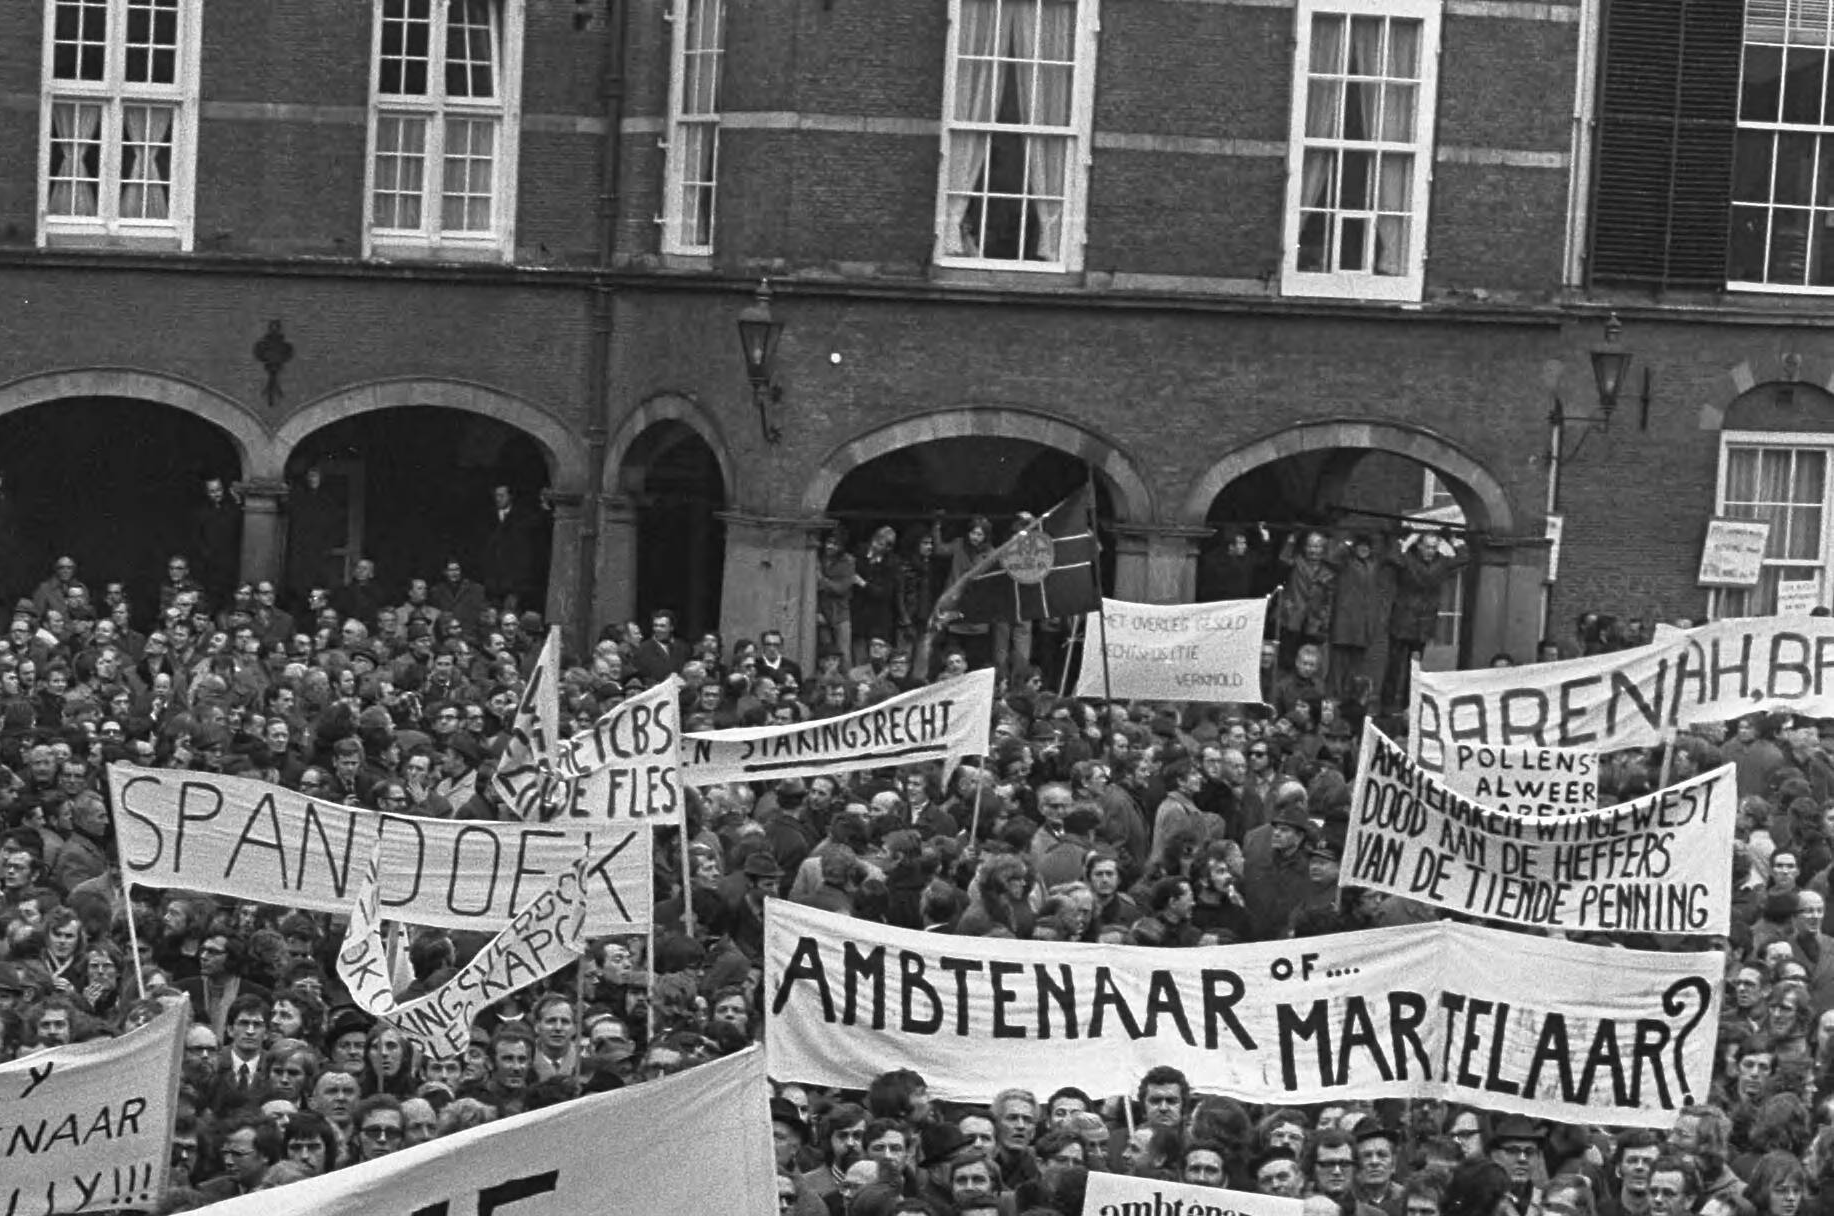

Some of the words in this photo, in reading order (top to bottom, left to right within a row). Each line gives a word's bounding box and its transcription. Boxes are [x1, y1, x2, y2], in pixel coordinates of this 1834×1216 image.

[741, 700, 954, 761] STAKINGSRECHT
[606, 765, 677, 818] FLES
[1360, 777, 1427, 838] DOOD
[1439, 818, 1486, 867] AAN
[1502, 841, 1539, 878] DE
[1554, 832, 1675, 882] HEFFERS
[1476, 775, 1596, 803] ALWEER
[121, 775, 638, 923] SPANDOEK
[1352, 829, 1405, 886] VAN
[1409, 847, 1455, 901] DE
[1464, 862, 1573, 927] TIENDE
[1579, 883, 1709, 932] PENNING
[774, 936, 1258, 1051] AMBTENAAR
[1279, 975, 1713, 1110] MARTELAAR?
